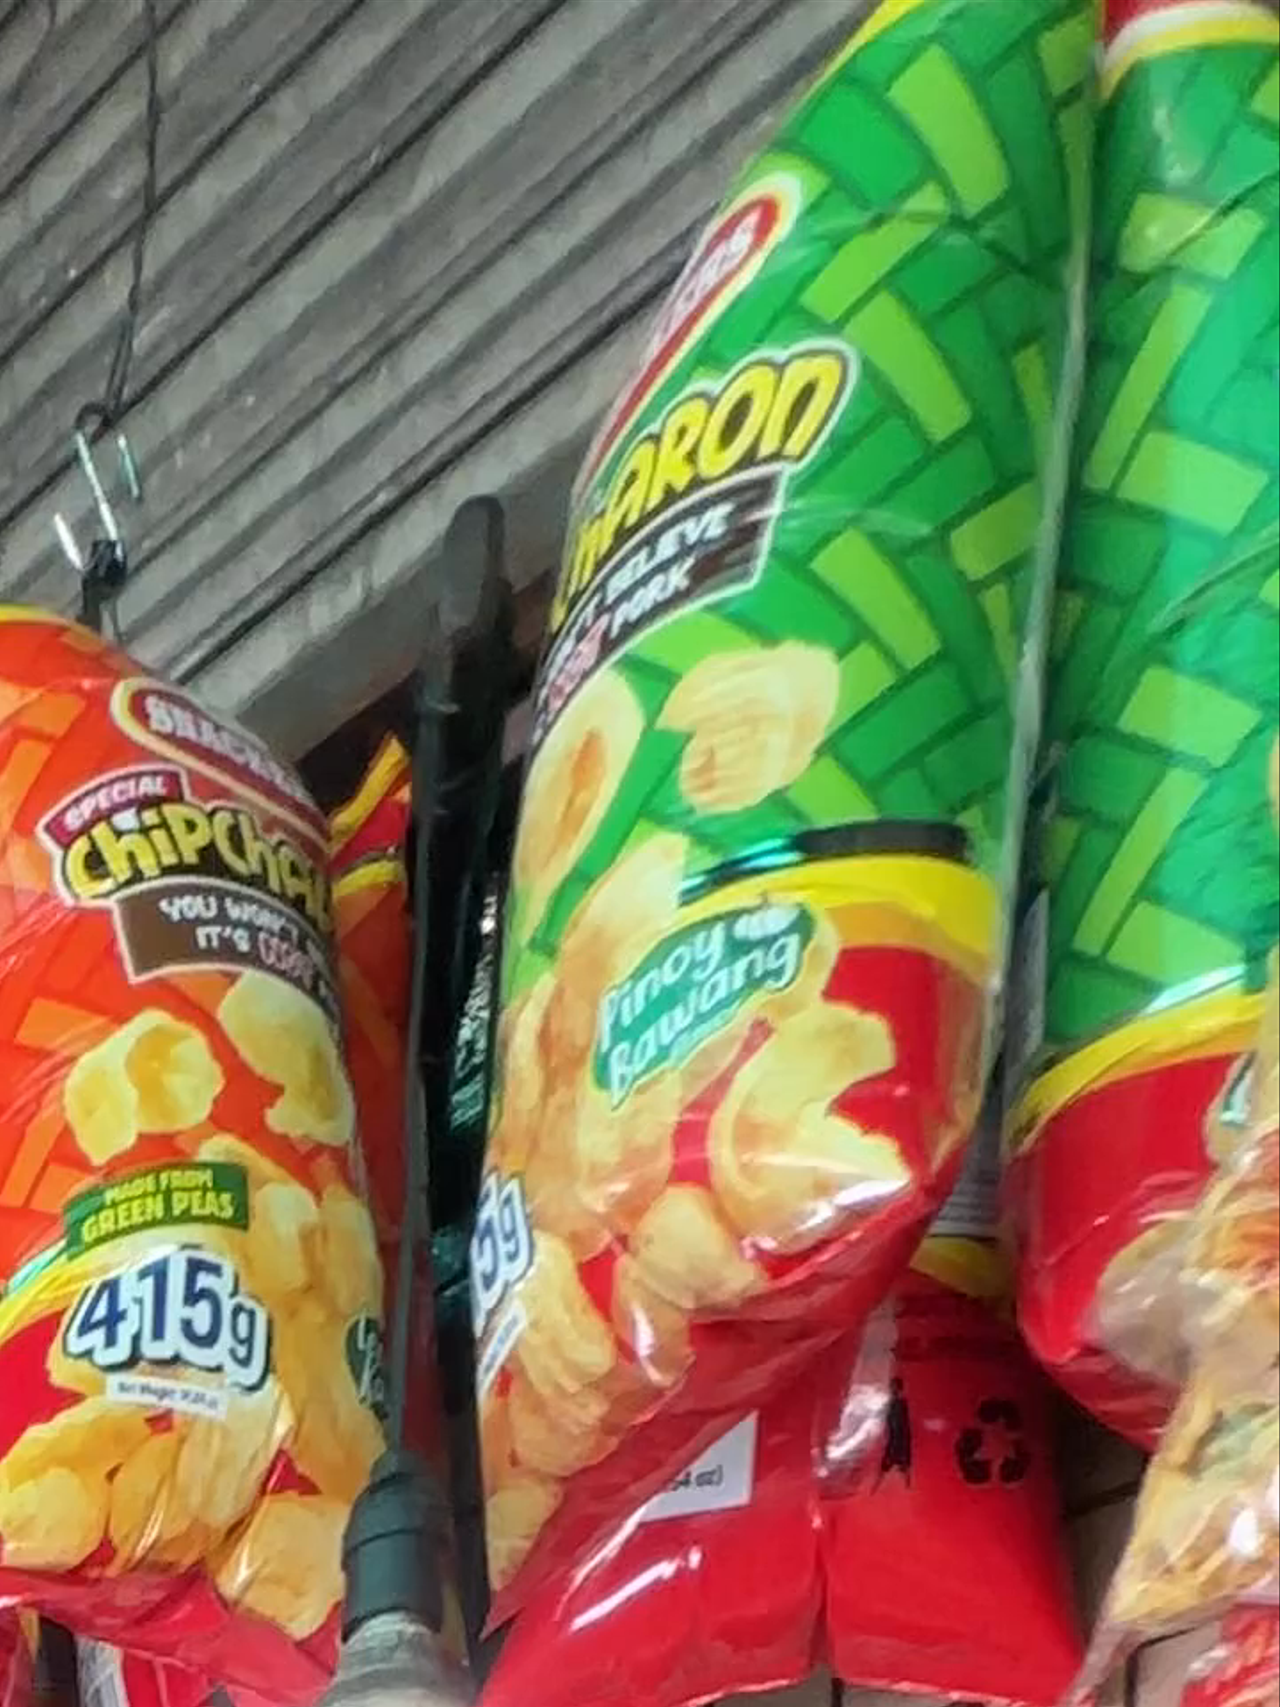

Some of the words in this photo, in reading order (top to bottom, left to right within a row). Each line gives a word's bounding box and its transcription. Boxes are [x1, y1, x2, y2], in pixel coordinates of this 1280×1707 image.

[64, 774, 168, 832] SPECIAL
[159, 896, 218, 922] YOU
[196, 926, 251, 952] IT'S
[600, 924, 724, 1036] Pinoy
[609, 935, 800, 1100] Bawang
[83, 1194, 165, 1241] GREEN
[171, 1189, 235, 1221] PEAS
[76, 1252, 257, 1370] 415g
